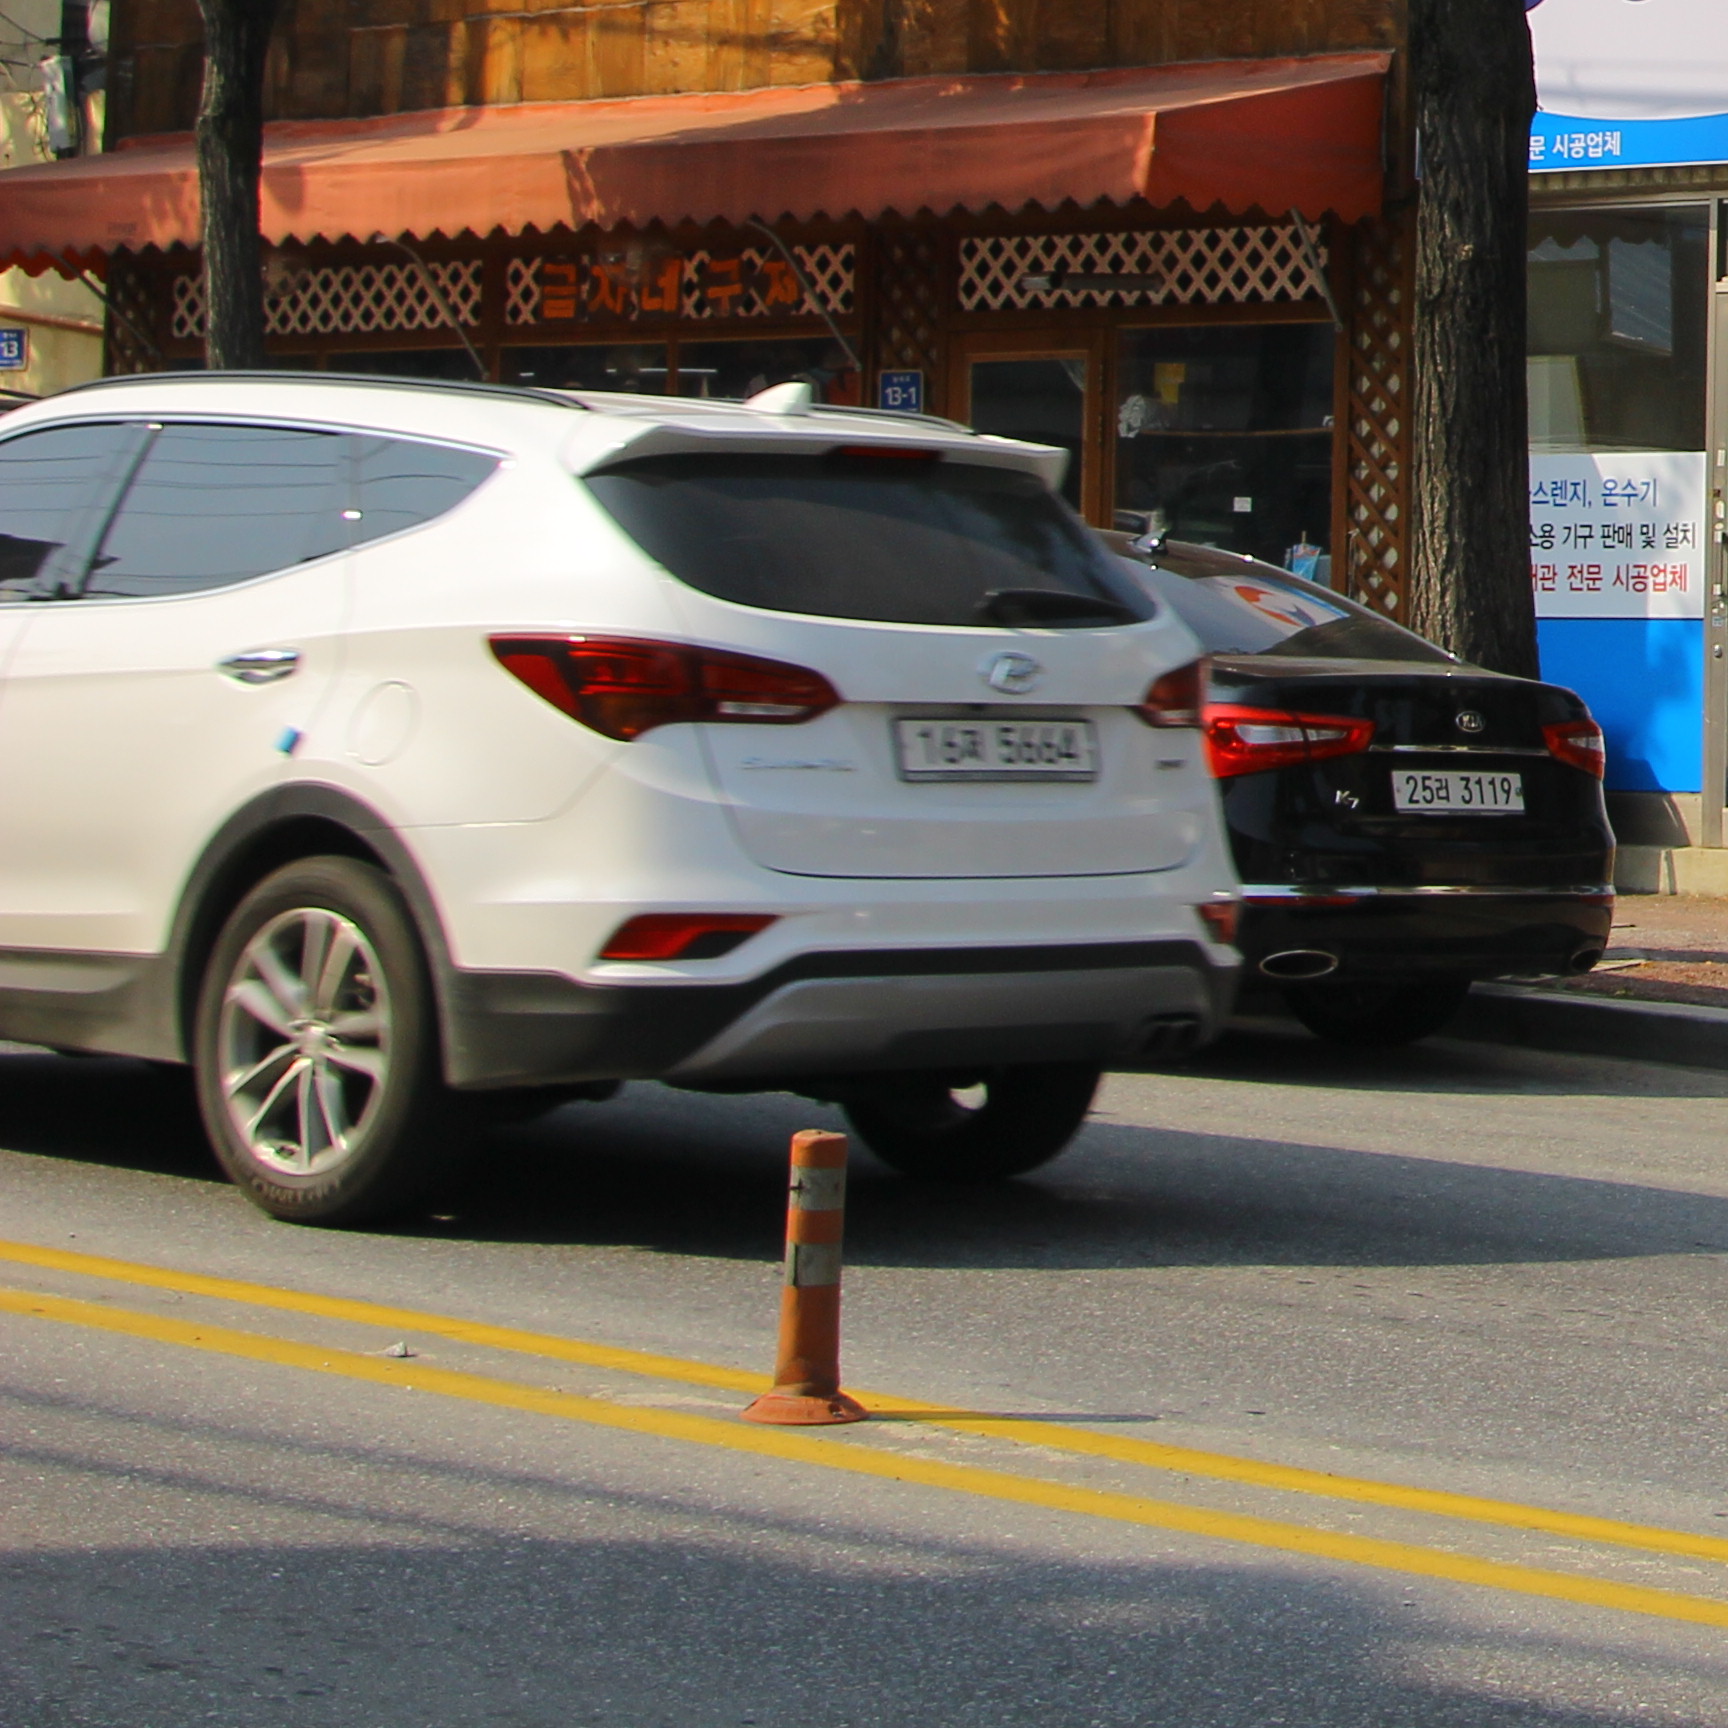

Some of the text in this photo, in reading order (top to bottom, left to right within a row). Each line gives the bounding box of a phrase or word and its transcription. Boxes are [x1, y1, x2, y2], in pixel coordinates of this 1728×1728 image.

[1529, 131, 1621, 160] 문 시공업체
[885, 386, 917, 405] 13-1
[1529, 478, 1657, 508] 스렌지, 온수기
[1562, 523, 1594, 549] 기구
[1601, 523, 1633, 549] 판매
[1640, 523, 1656, 549] 및
[1663, 522, 1696, 549] 설치
[1567, 563, 1603, 592] 전문
[1612, 563, 1689, 593] 시공업체
[1335, 790, 1359, 808] K7
[1405, 775, 1512, 805] 25러 3119
